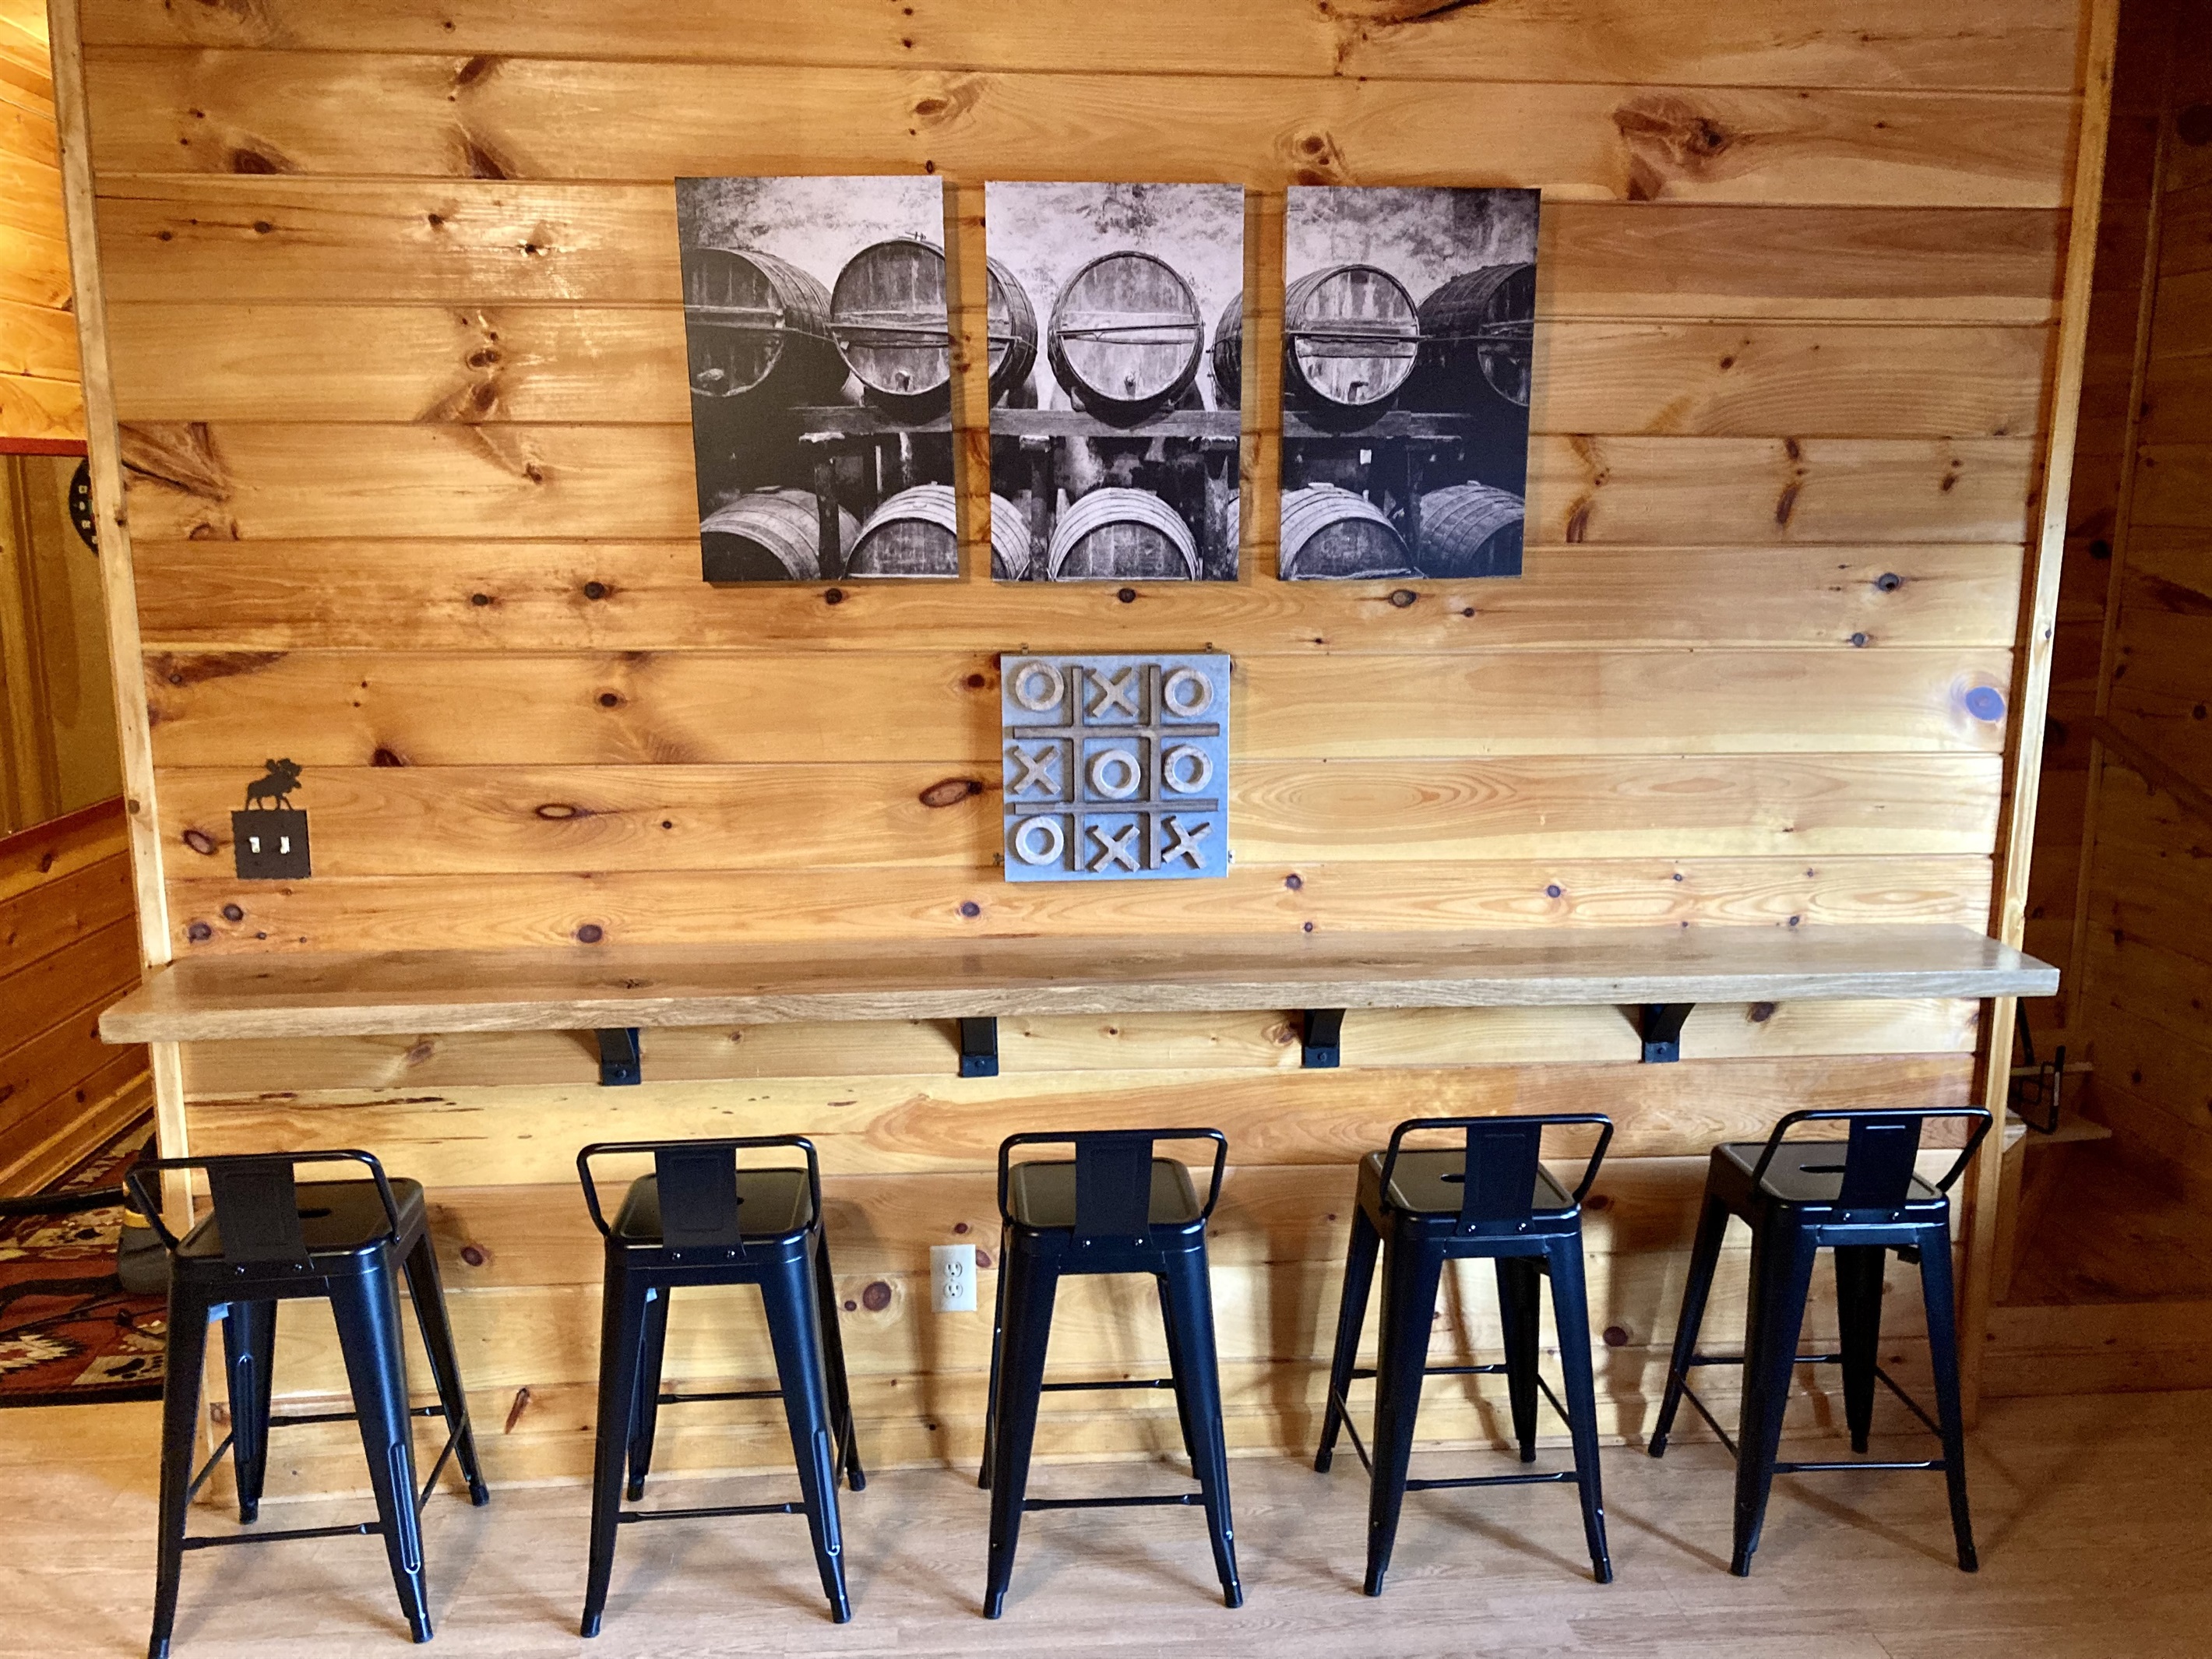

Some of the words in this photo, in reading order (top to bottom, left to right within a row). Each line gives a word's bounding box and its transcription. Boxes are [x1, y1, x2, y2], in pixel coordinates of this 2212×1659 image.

[1016, 663, 1064, 710] O
[1091, 667, 1139, 717] X
[1164, 669, 1213, 717] O
[1013, 746, 1061, 794] X
[1093, 750, 1141, 798] O
[1164, 745, 1213, 793] O
[1016, 817, 1064, 865] O
[1092, 825, 1140, 872] X
[1162, 817, 1213, 869] X
